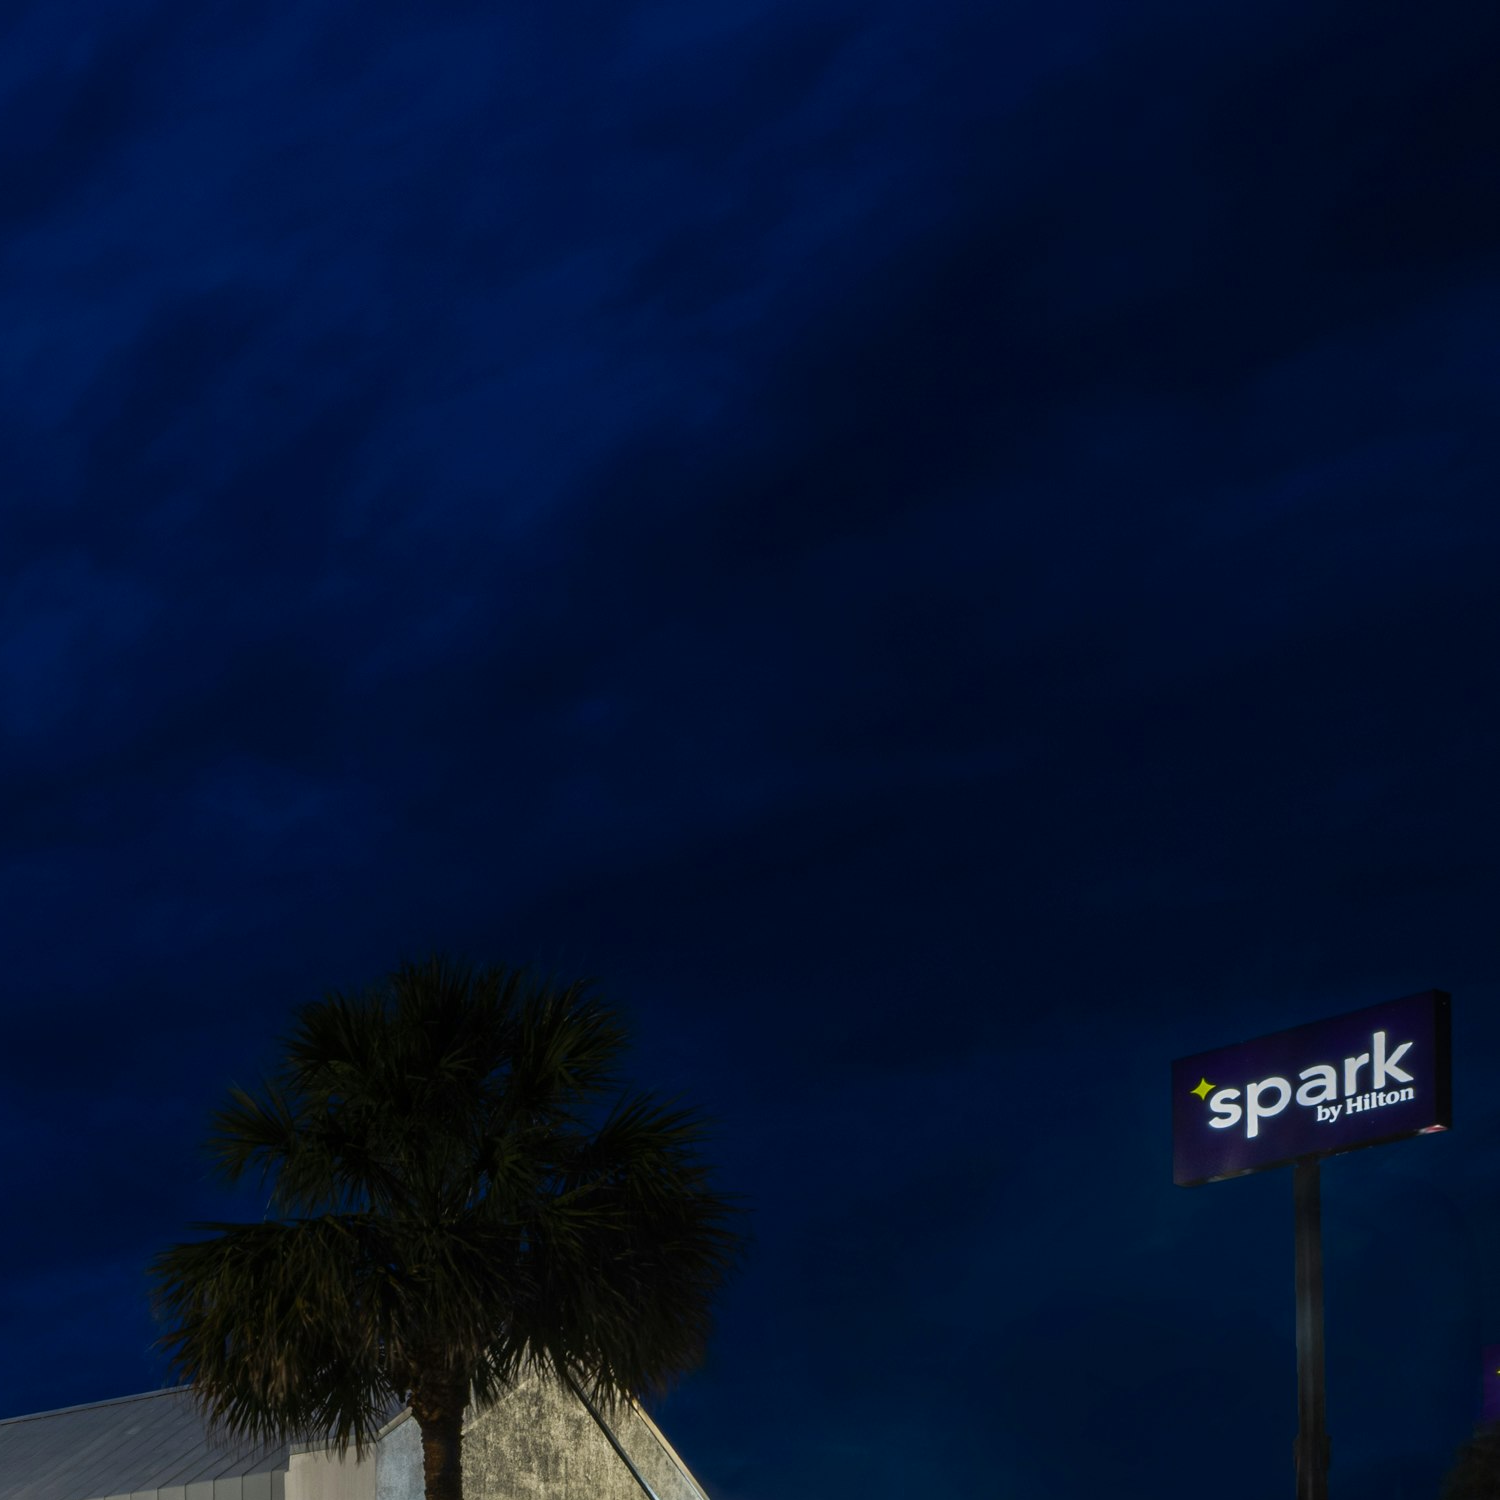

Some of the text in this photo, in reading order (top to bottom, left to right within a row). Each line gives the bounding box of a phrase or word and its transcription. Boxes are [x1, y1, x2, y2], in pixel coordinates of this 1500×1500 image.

[1209, 1031, 1414, 1138] spark
[1317, 1087, 1414, 1123] by Hilton
